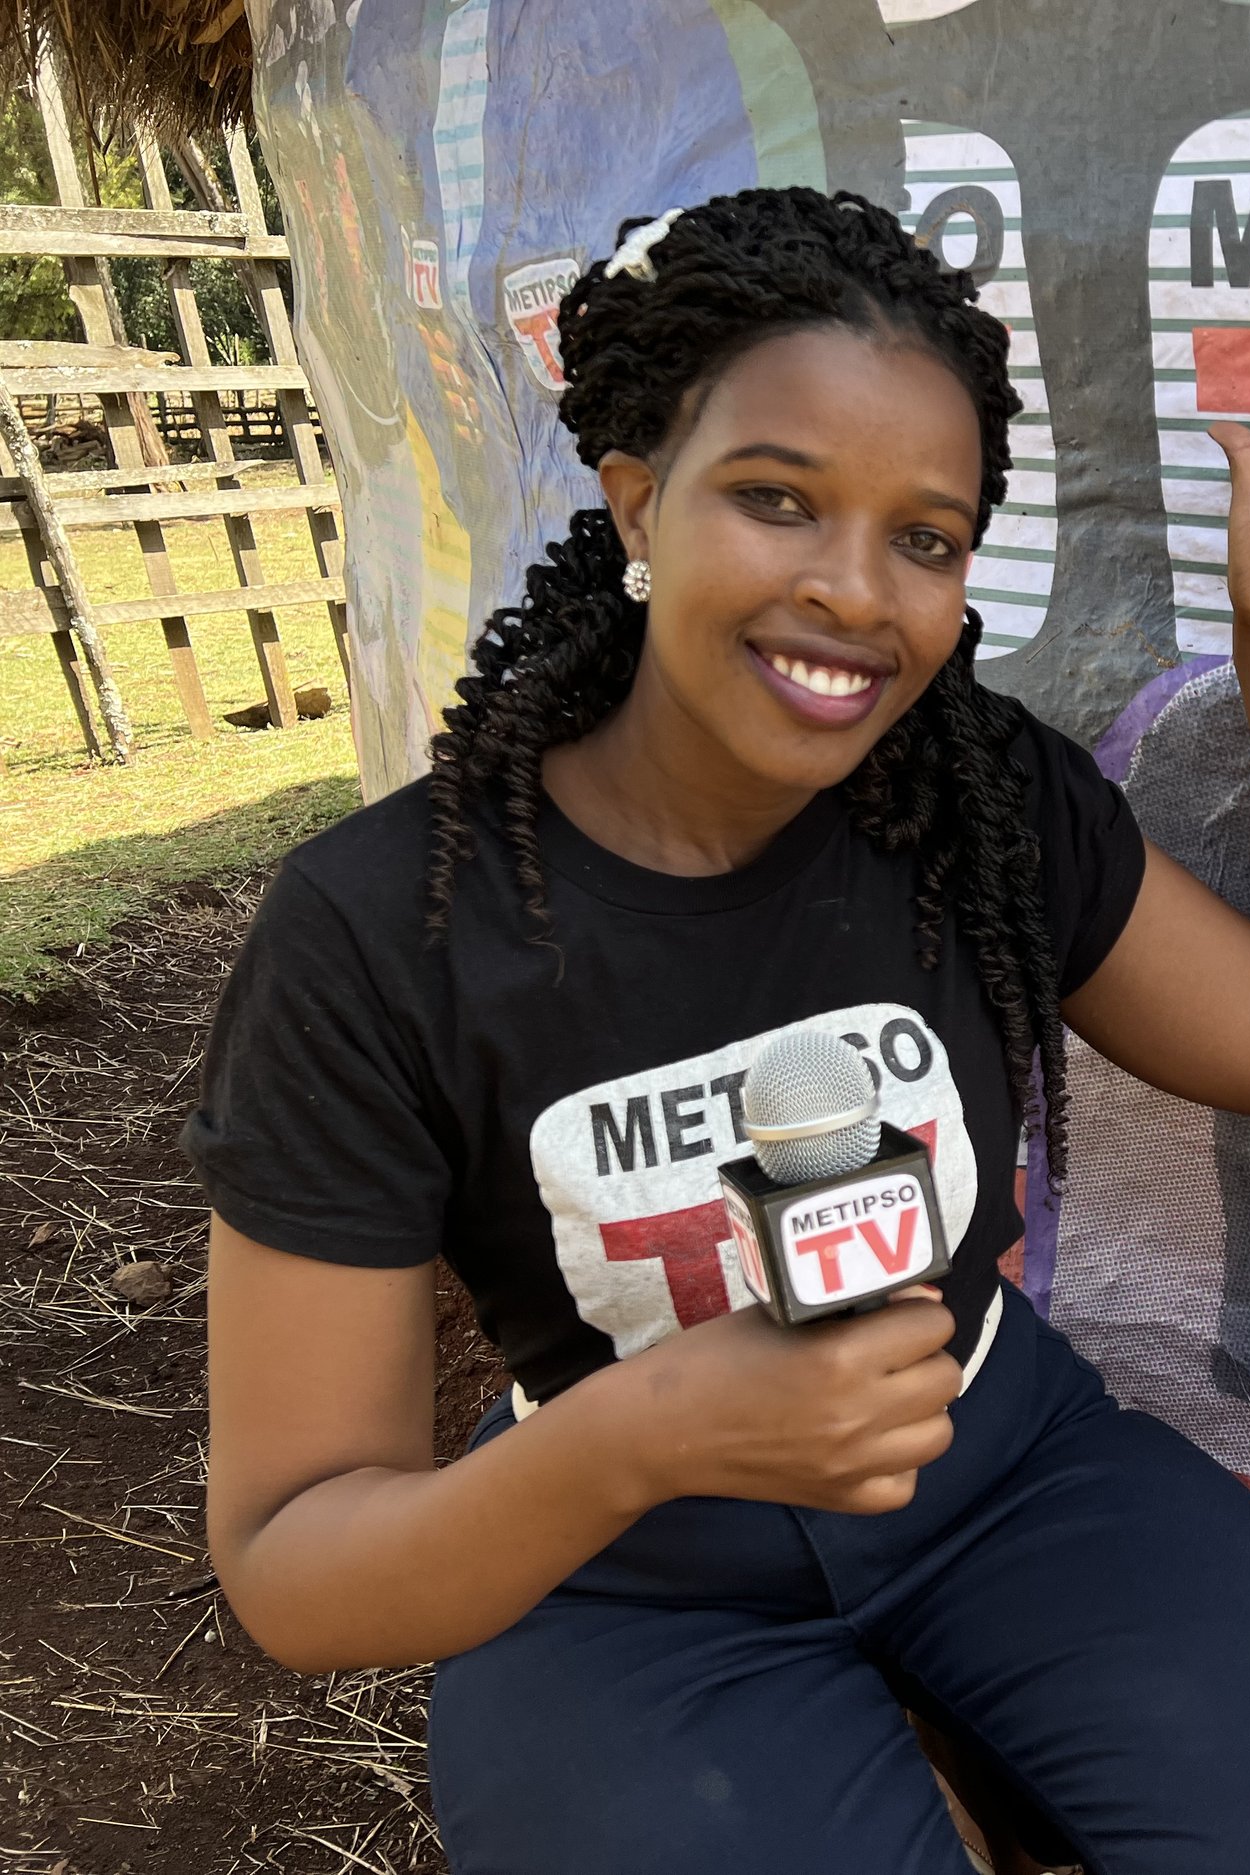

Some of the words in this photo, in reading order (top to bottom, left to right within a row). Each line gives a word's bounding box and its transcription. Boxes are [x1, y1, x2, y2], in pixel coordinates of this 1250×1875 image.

[514, 308, 564, 382] T
[791, 1185, 918, 1235] METIPSO
[795, 1206, 920, 1295] TV
